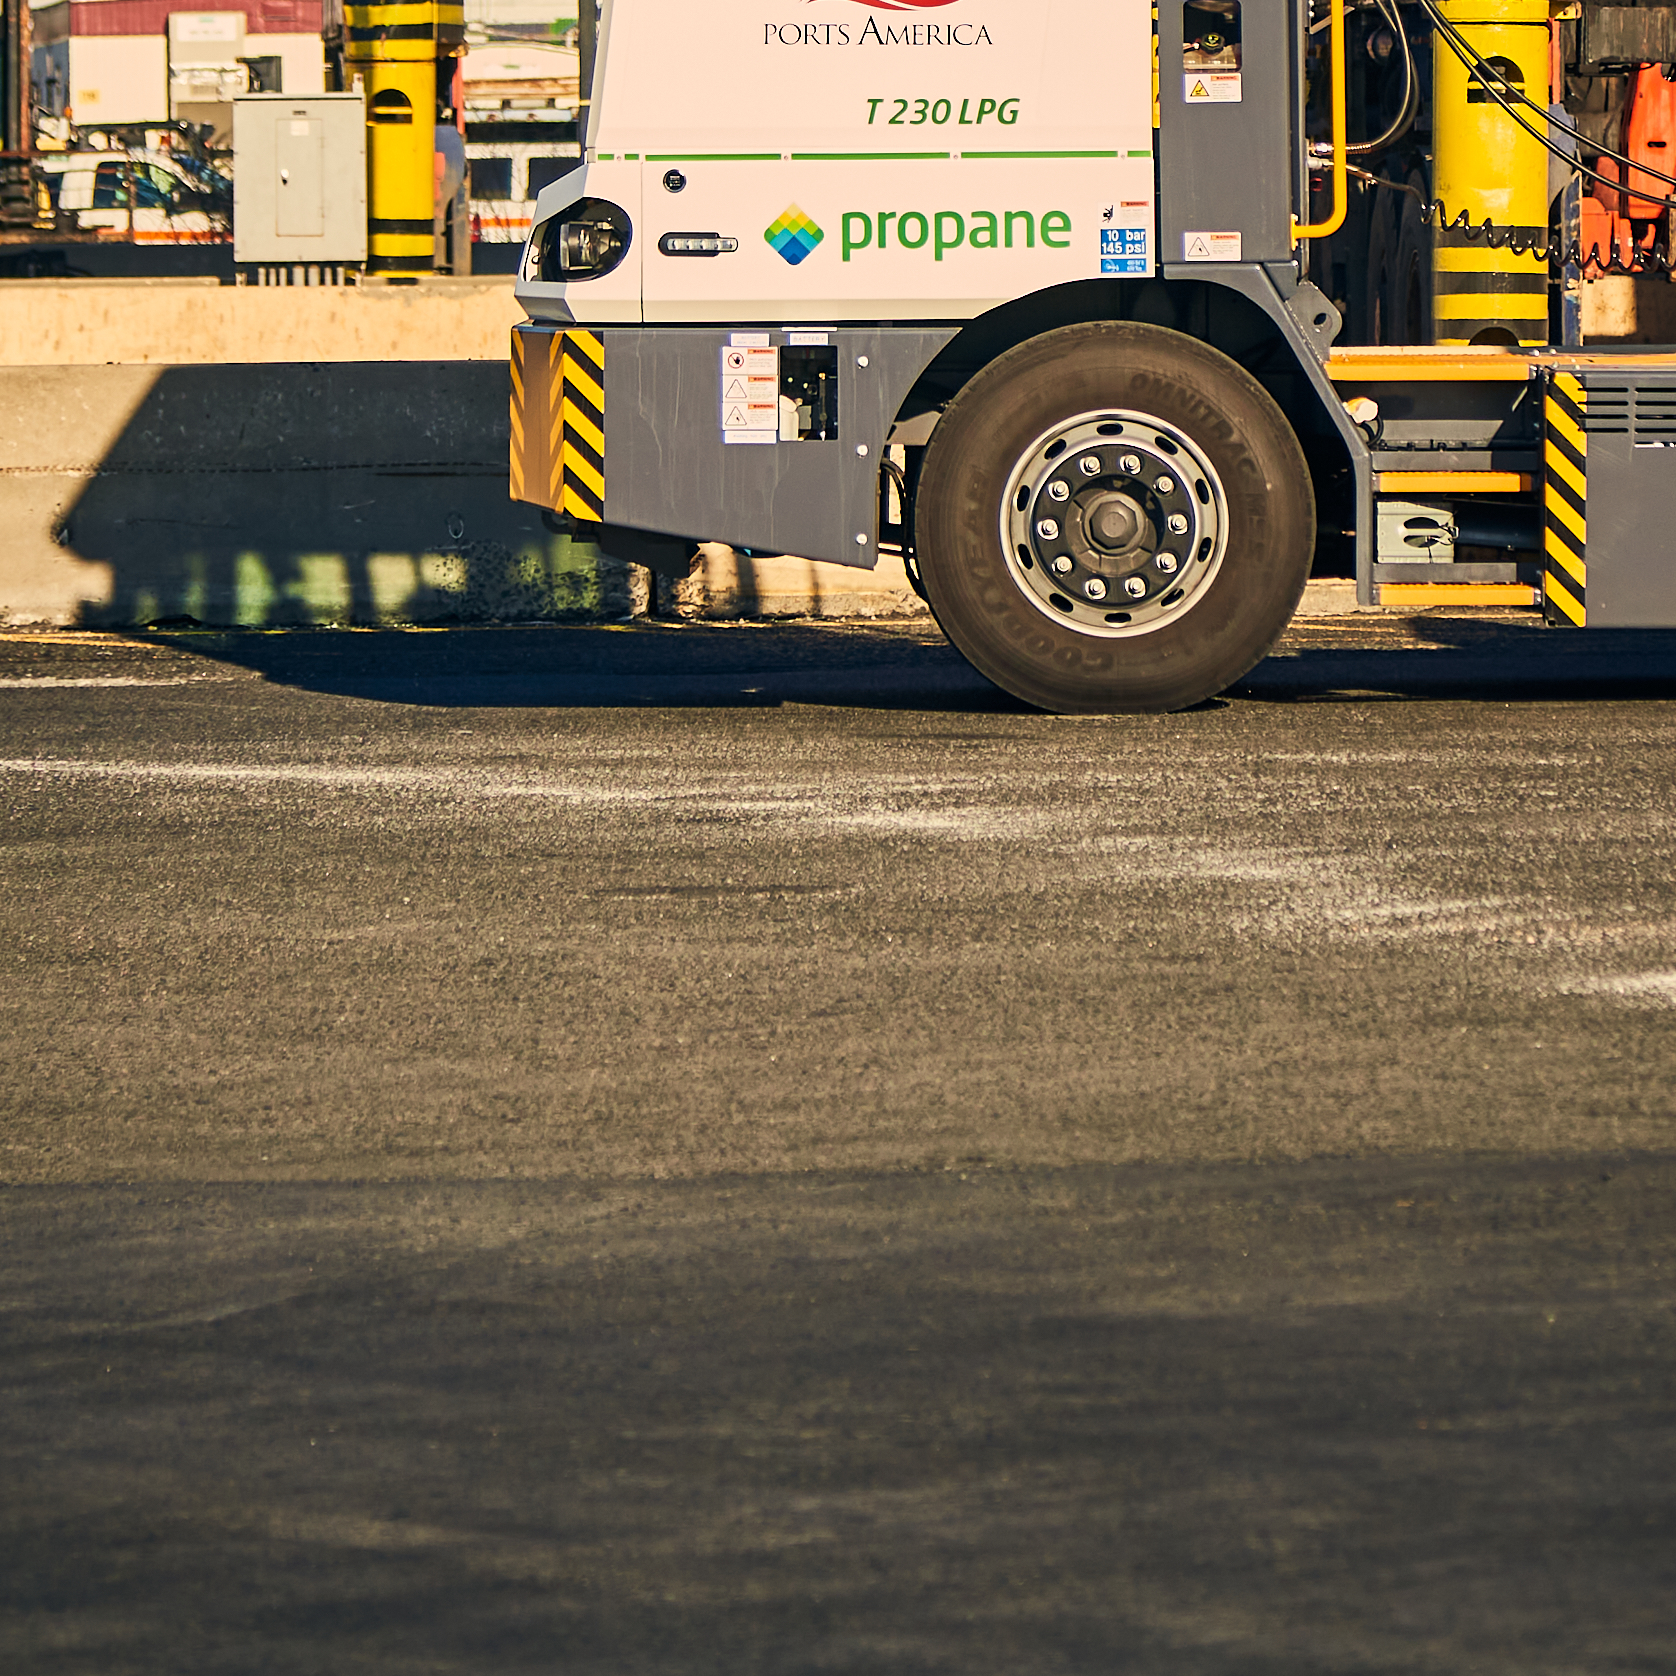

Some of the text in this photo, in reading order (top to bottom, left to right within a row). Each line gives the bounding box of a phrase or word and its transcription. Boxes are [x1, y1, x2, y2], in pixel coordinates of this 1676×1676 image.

[764, 23, 850, 46] PORTS
[867, 98, 1020, 125] T 230 LPG
[841, 210, 1072, 262] propane
[1107, 229, 1145, 241] 10 bar
[1102, 241, 1145, 255] 145 psi
